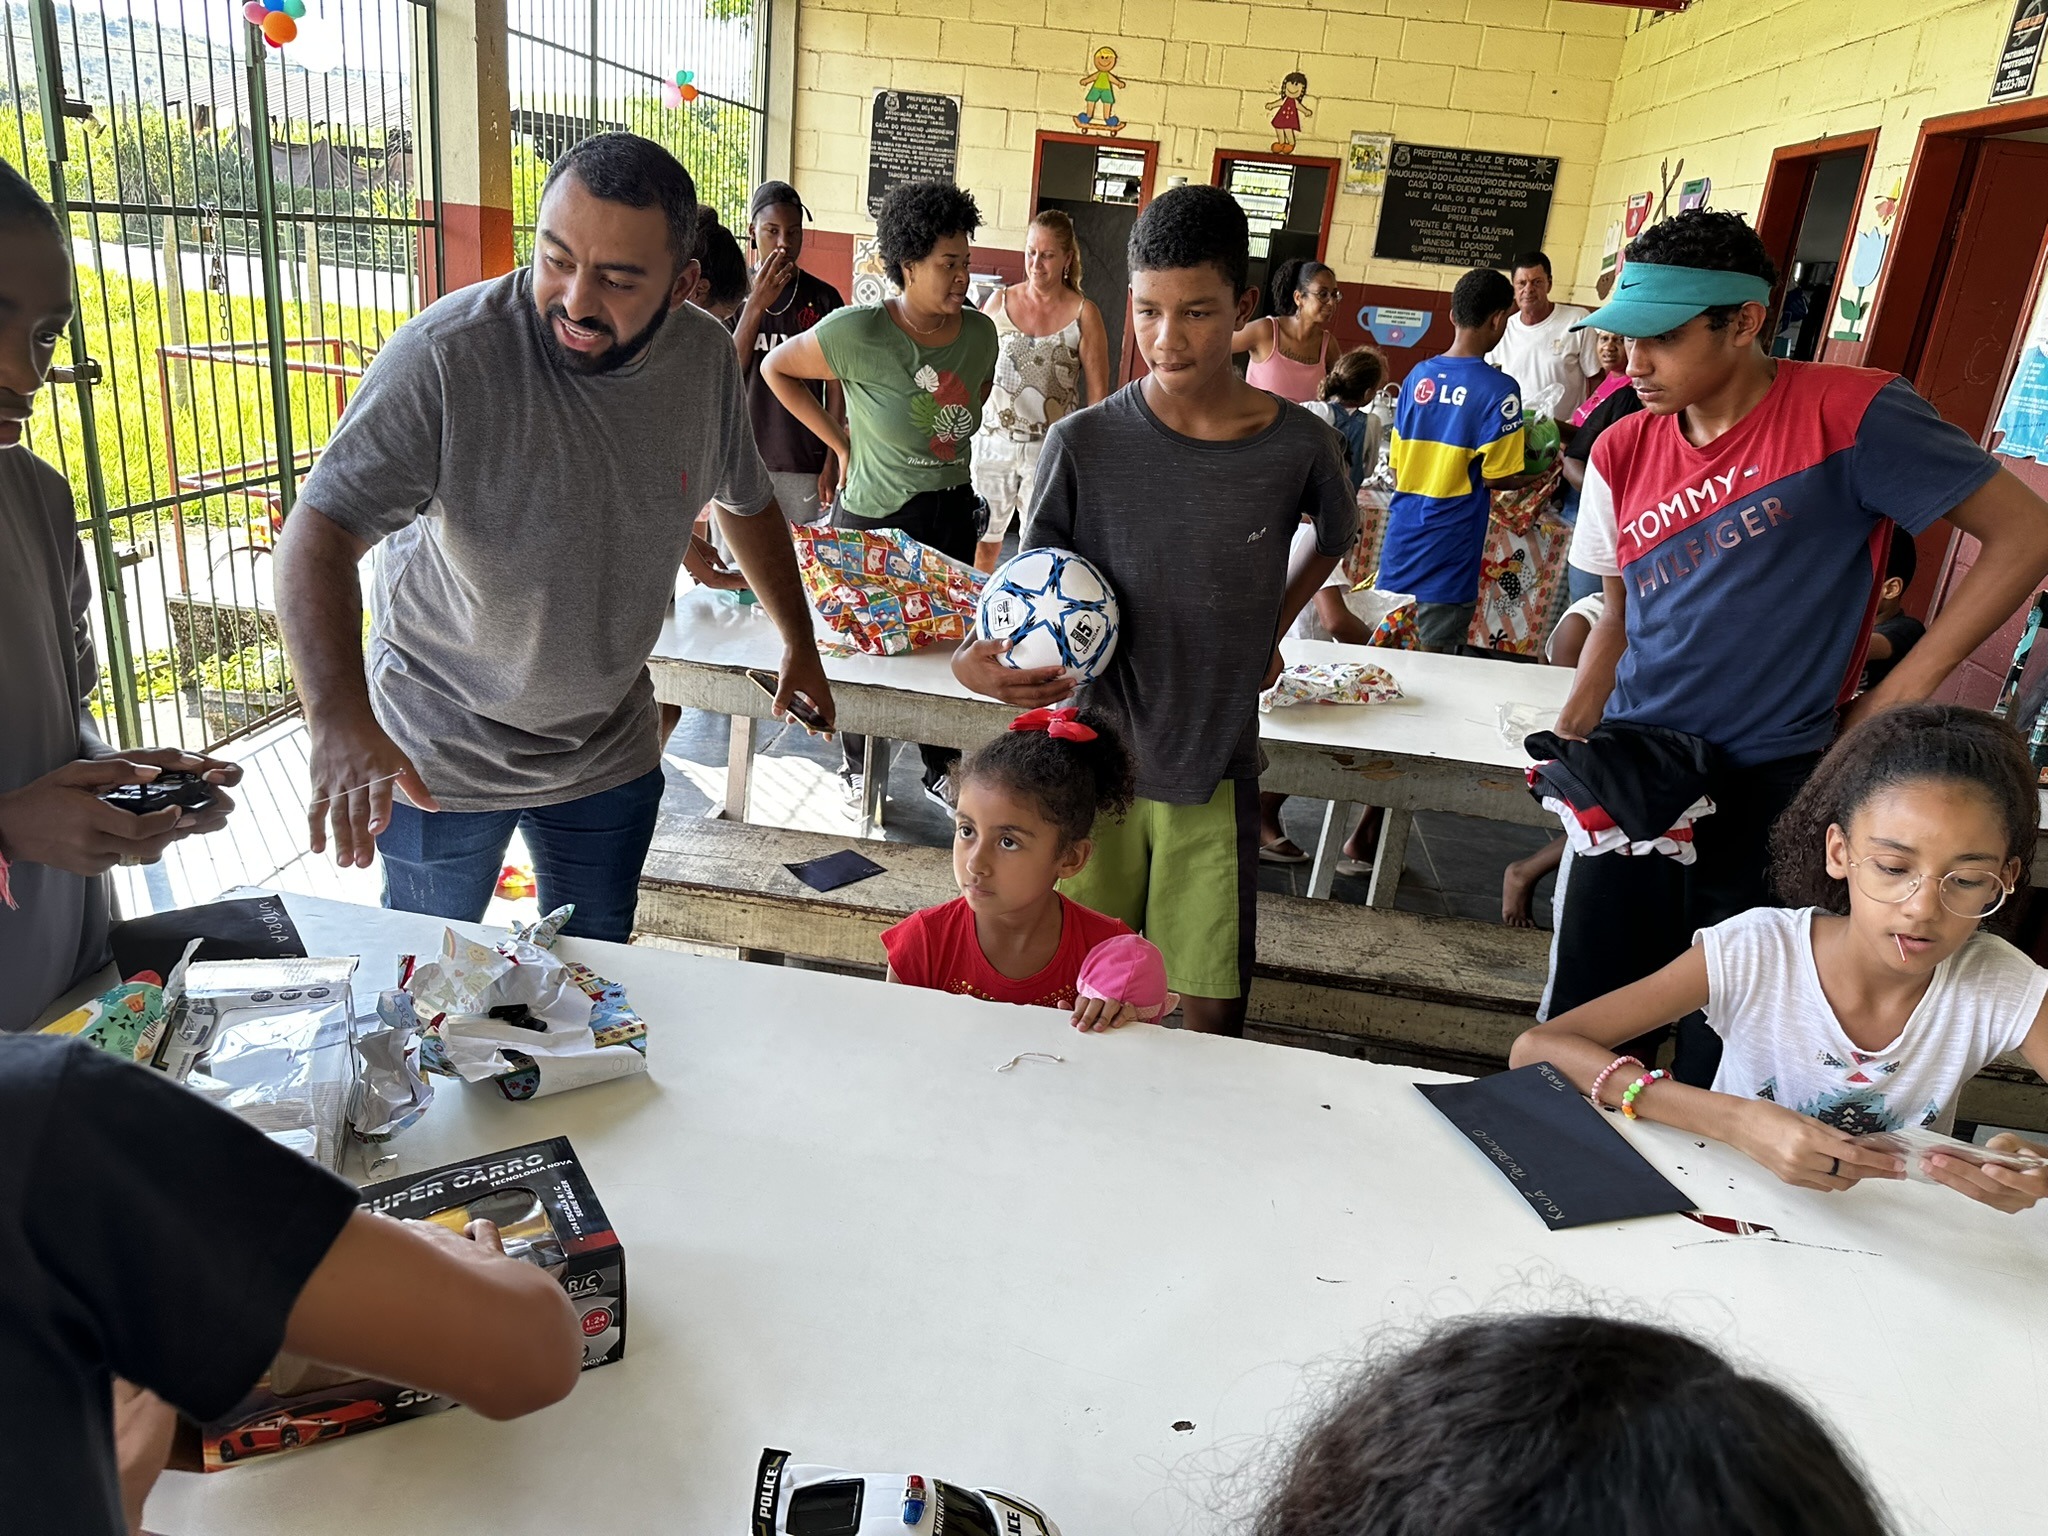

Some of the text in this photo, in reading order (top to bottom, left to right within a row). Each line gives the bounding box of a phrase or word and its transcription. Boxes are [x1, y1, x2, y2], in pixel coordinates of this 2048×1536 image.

[2001, 55, 2034, 71] PROTEGIDO
[906, 95, 937, 104] PREFEITURA
[925, 128, 954, 136] JARDINEIRO
[1413, 148, 1457, 160] PREFEITURA
[1475, 155, 1491, 164] JUIZ
[1495, 156, 1505, 164] DE
[1508, 158, 1528, 167] FORA
[1408, 180, 1527, 198] CASA DO PEQUENO JARDINEIRO
[1438, 174, 1448, 182] DO
[1449, 175, 1498, 186] LABORATÓRIO
[1498, 179, 1507, 187] DE
[1508, 180, 1553, 191] INFORMÁTICA
[1432, 204, 1497, 217] ALBERTO BEJANI
[1510, 200, 1528, 208] 2005
[1447, 214, 1478, 222] PREFEITO
[1410, 219, 1514, 236] VICENTE DE PAULA OLIVEIRA
[1419, 228, 1457, 238] PRESIDENTE
[1422, 237, 1455, 248] VANESSA
[1411, 245, 1468, 257] SUPERINTENDENTE
[1471, 250, 1480, 258] DA
[1444, 256, 1470, 266] BANCO
[1439, 385, 1467, 406] LG
[1623, 466, 1736, 547] TOMMY
[1635, 496, 1793, 598] HILFIGER
[1083, 625, 1102, 654] OFFICIAL
[452, 1153, 544, 1190] CARRO
[489, 1158, 573, 1188] TECNOLOGIA NOVA
[568, 1275, 598, 1292] R/C
[585, 1313, 606, 1326] 1:24
[582, 1355, 608, 1367] NOVA
[759, 1468, 779, 1519] POLICE
